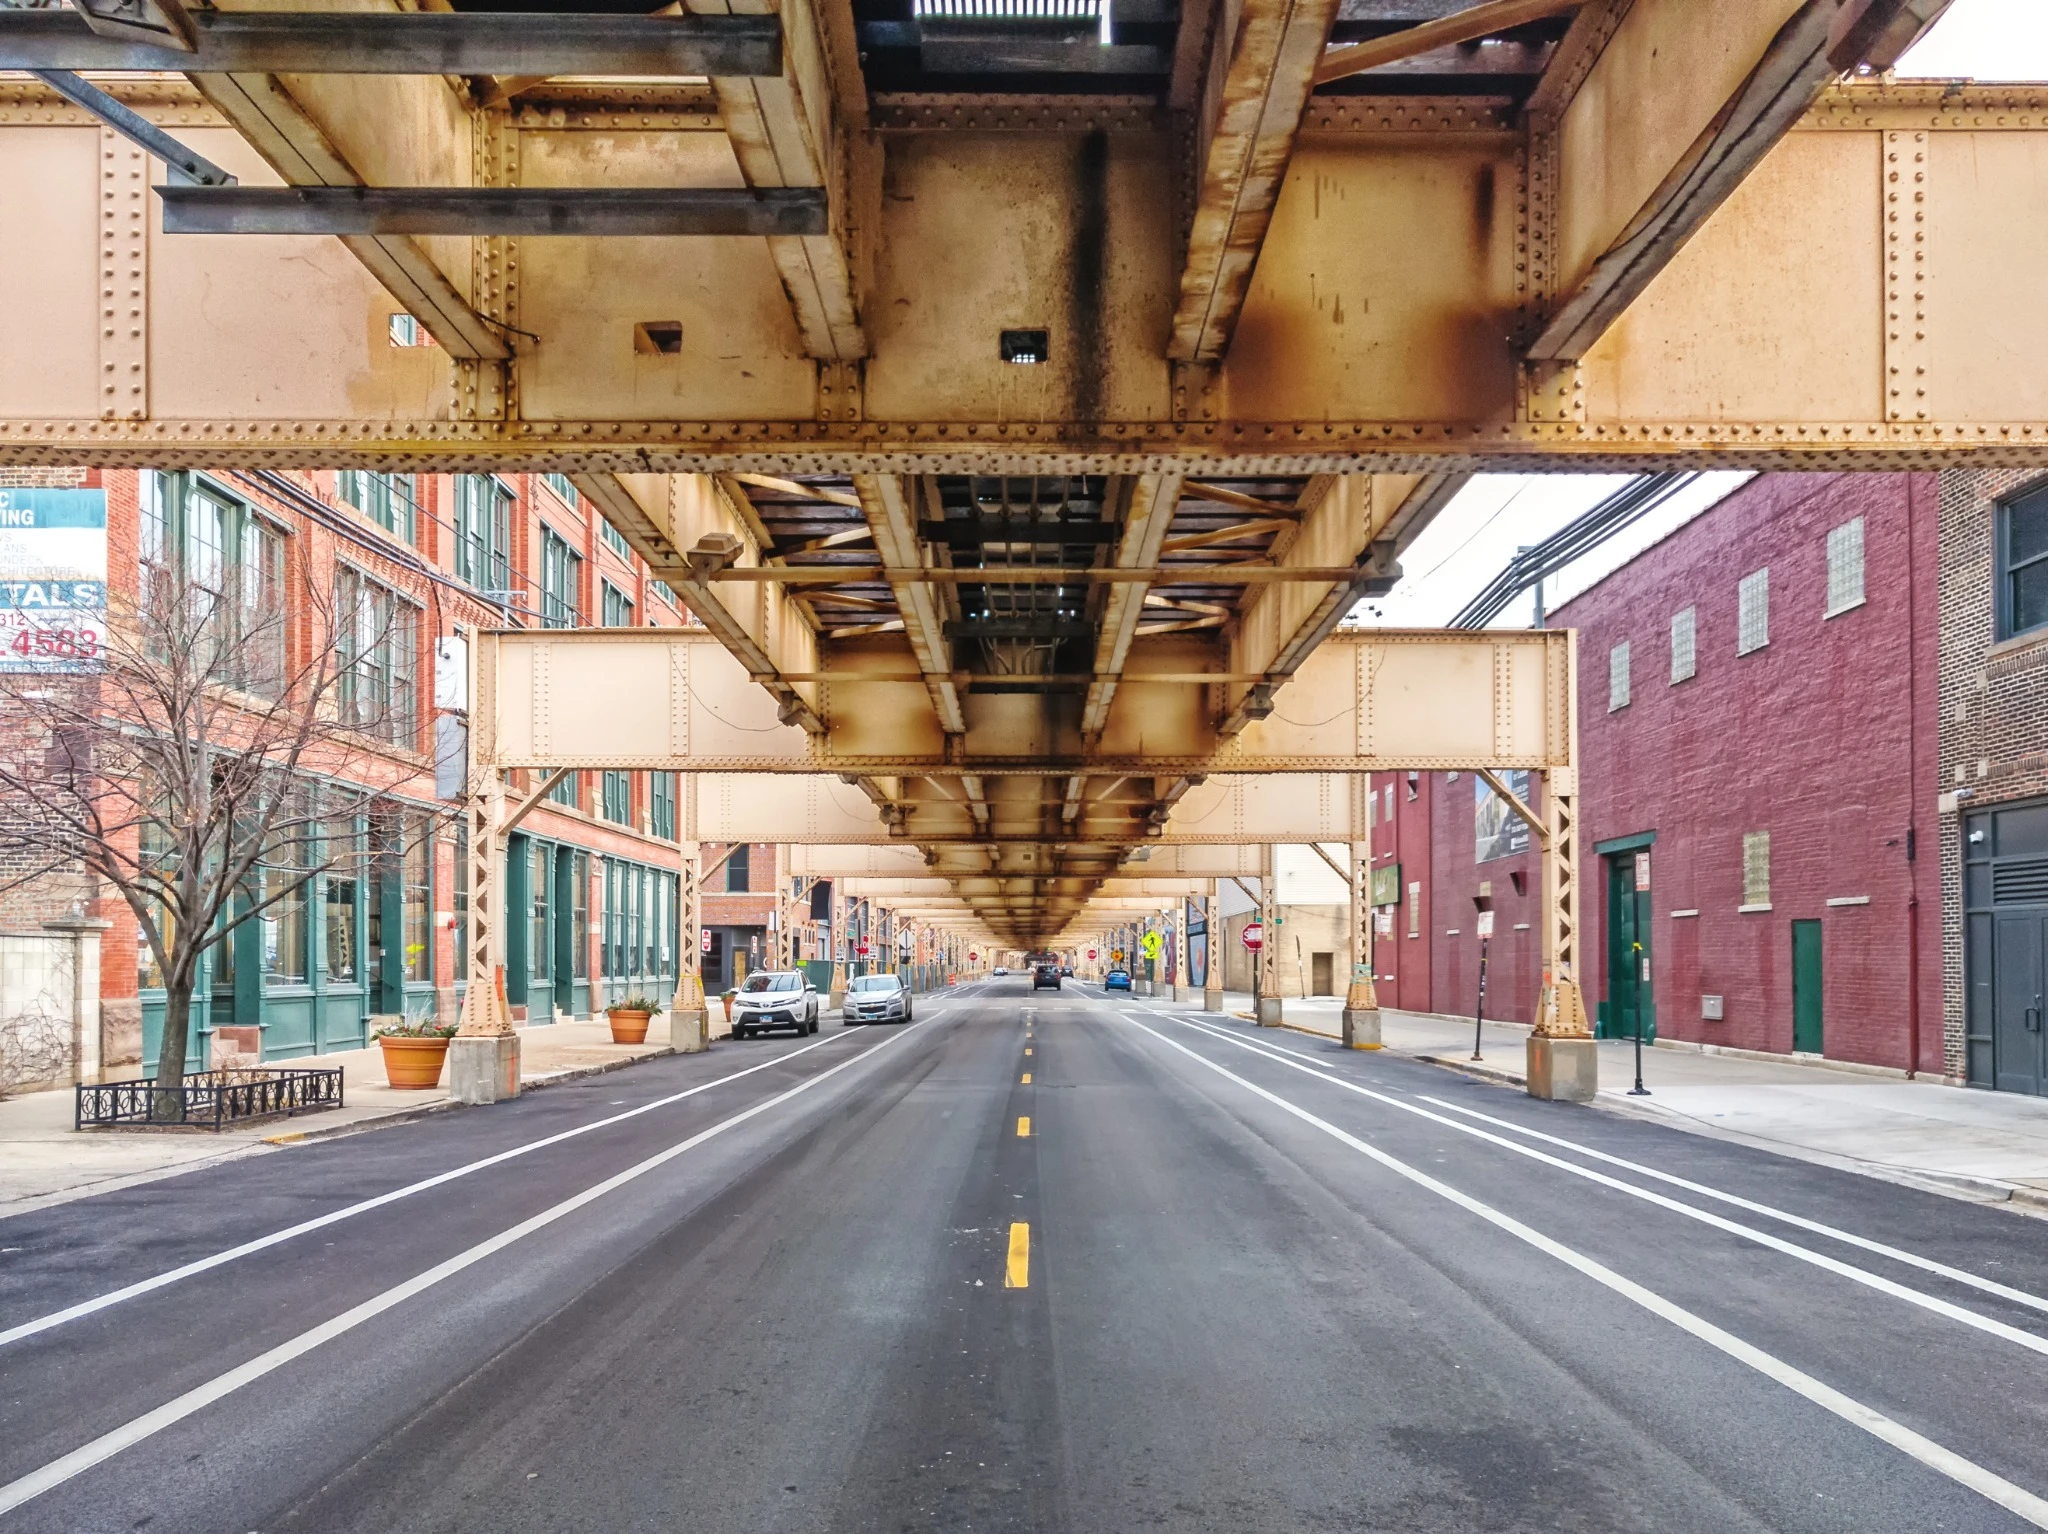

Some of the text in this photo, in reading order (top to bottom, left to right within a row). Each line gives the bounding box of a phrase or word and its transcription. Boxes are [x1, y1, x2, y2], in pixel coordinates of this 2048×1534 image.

[0, 509, 35, 526] ING
[0, 543, 28, 554] ANS
[2, 583, 99, 607] TALS
